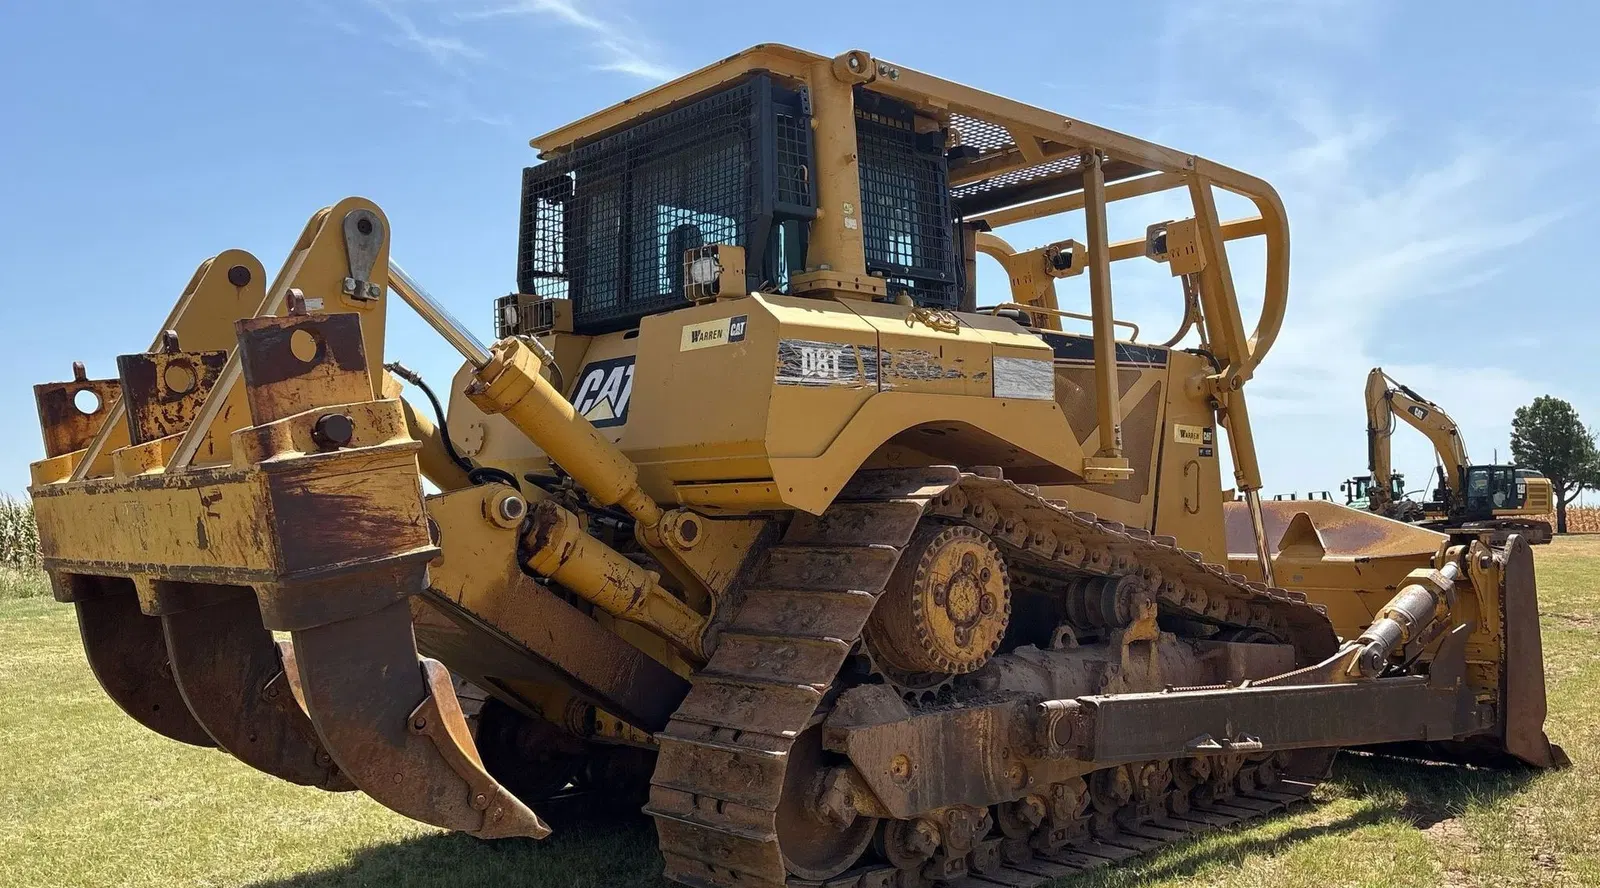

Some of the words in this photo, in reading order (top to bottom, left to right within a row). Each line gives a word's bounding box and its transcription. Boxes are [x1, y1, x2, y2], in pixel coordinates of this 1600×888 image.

[691, 329, 723, 343] WARREN
[730, 322, 746, 336] CAT
[802, 347, 842, 377] D8T
[573, 364, 635, 418] CAT
